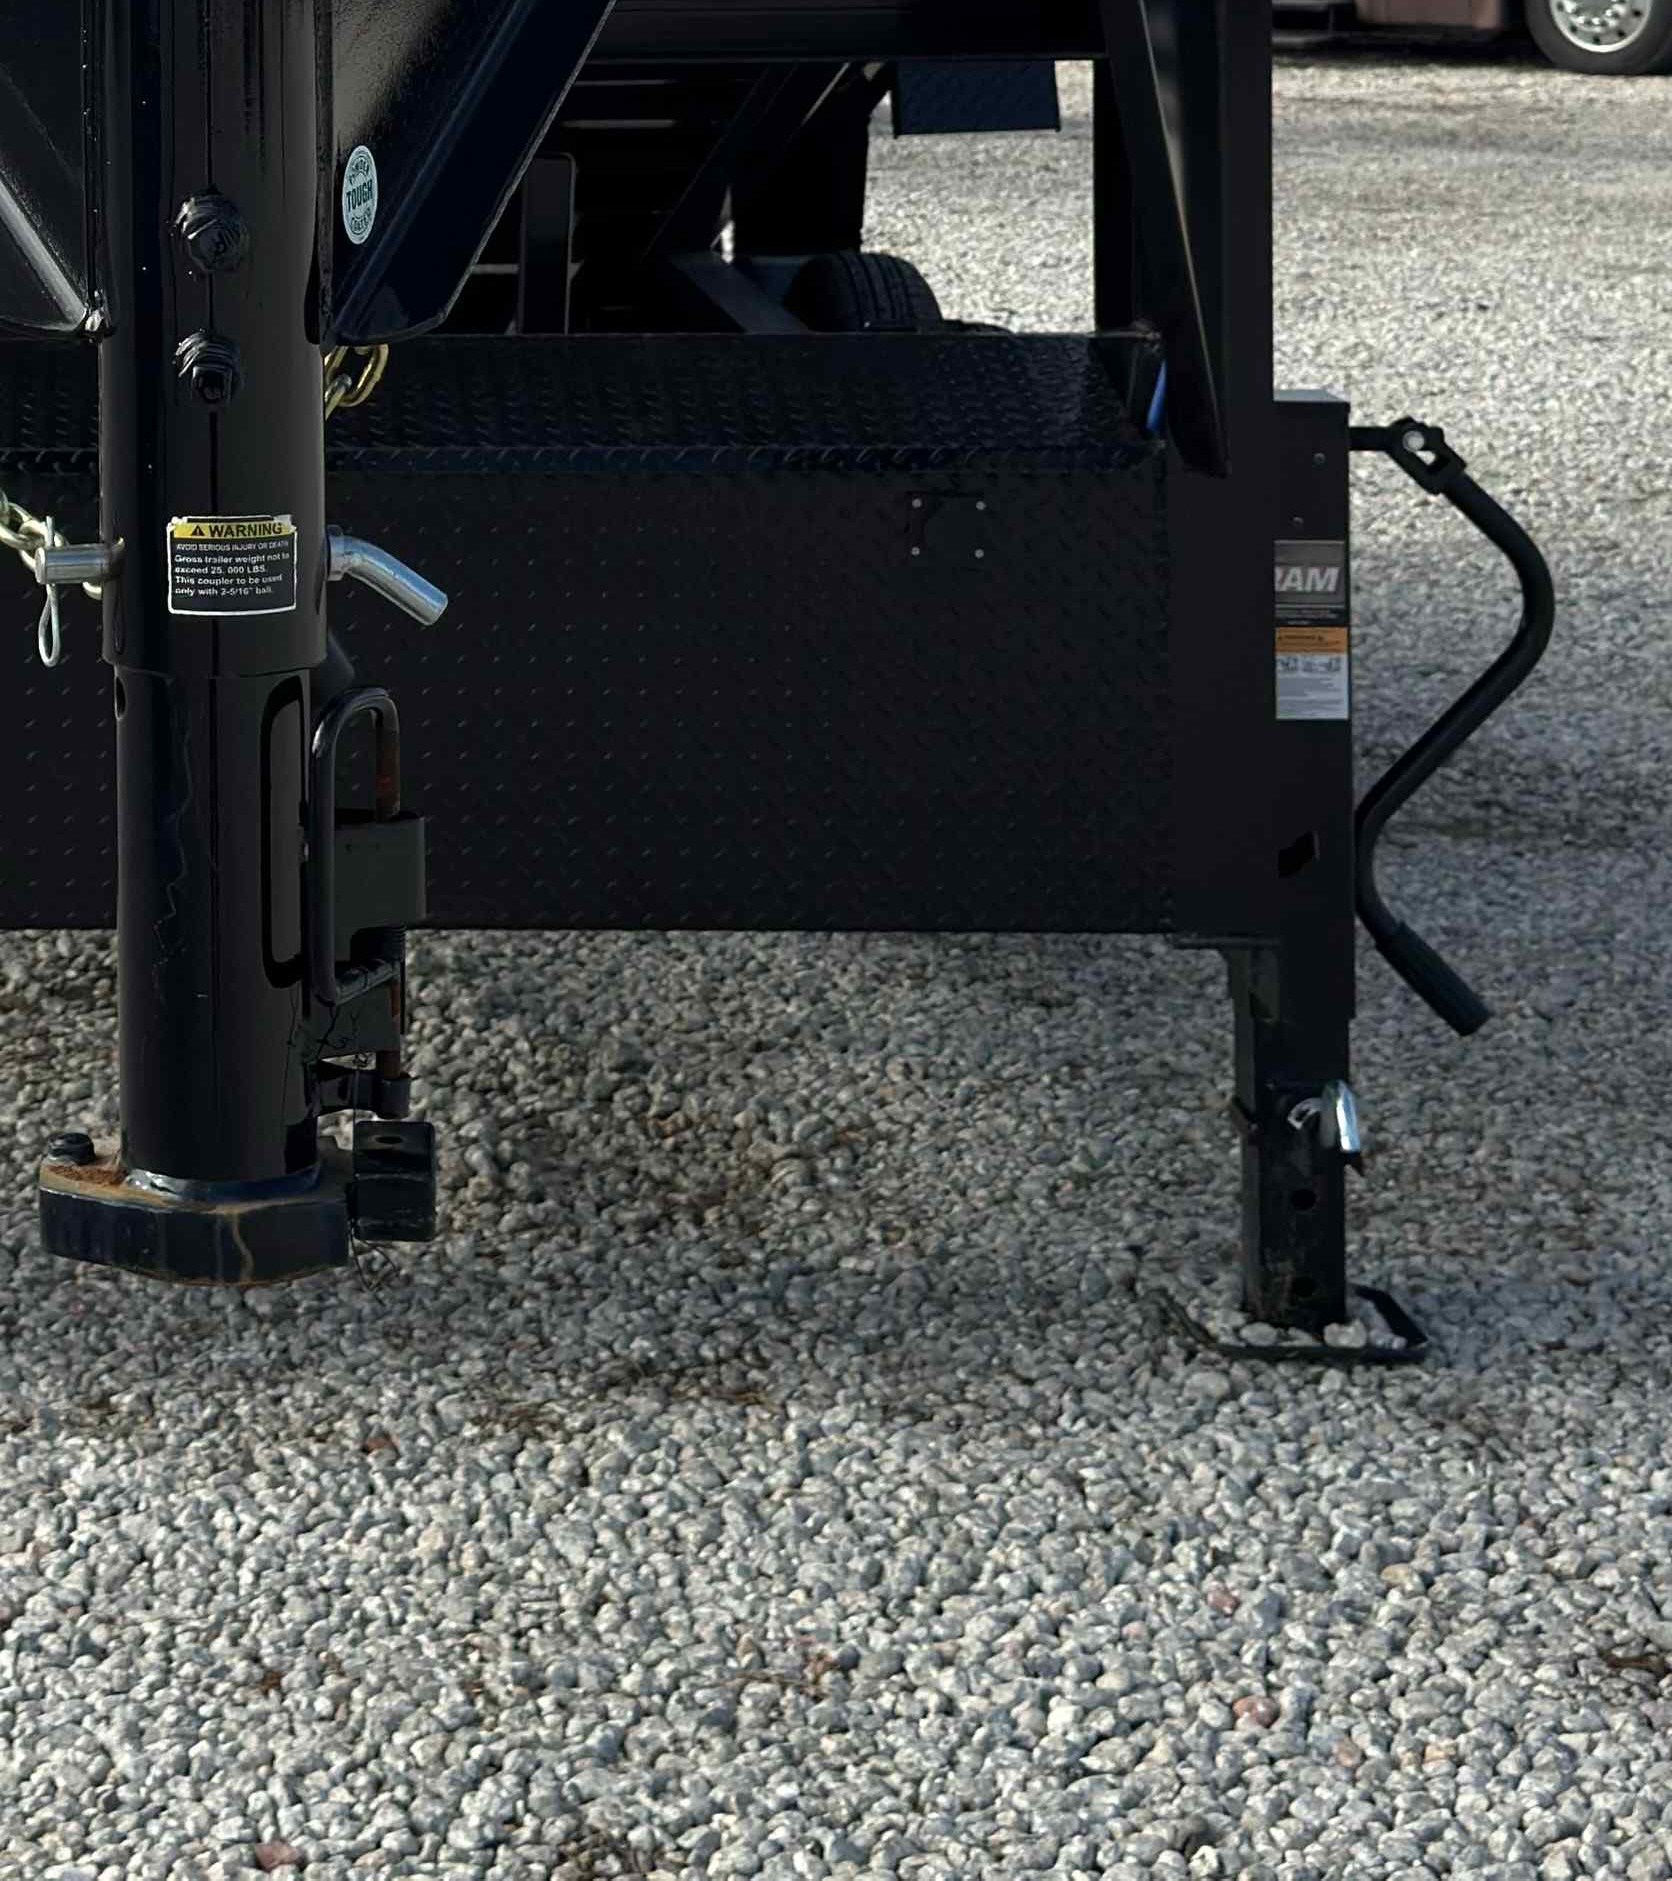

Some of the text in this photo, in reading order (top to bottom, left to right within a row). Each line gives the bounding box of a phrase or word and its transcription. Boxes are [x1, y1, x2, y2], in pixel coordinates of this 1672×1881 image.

[346, 179, 373, 212] TOUGH
[208, 523, 283, 537] WARNING
[176, 543, 198, 551] AVOID
[198, 543, 231, 551] SERIOUS
[231, 543, 257, 551] INJURY
[257, 542, 268, 550] OR
[175, 552, 290, 565] Gross trailer weight not to
[175, 566, 208, 574] exceed
[175, 574, 283, 586] This coupler to be used
[175, 587, 195, 597] only
[197, 587, 218, 596] with
